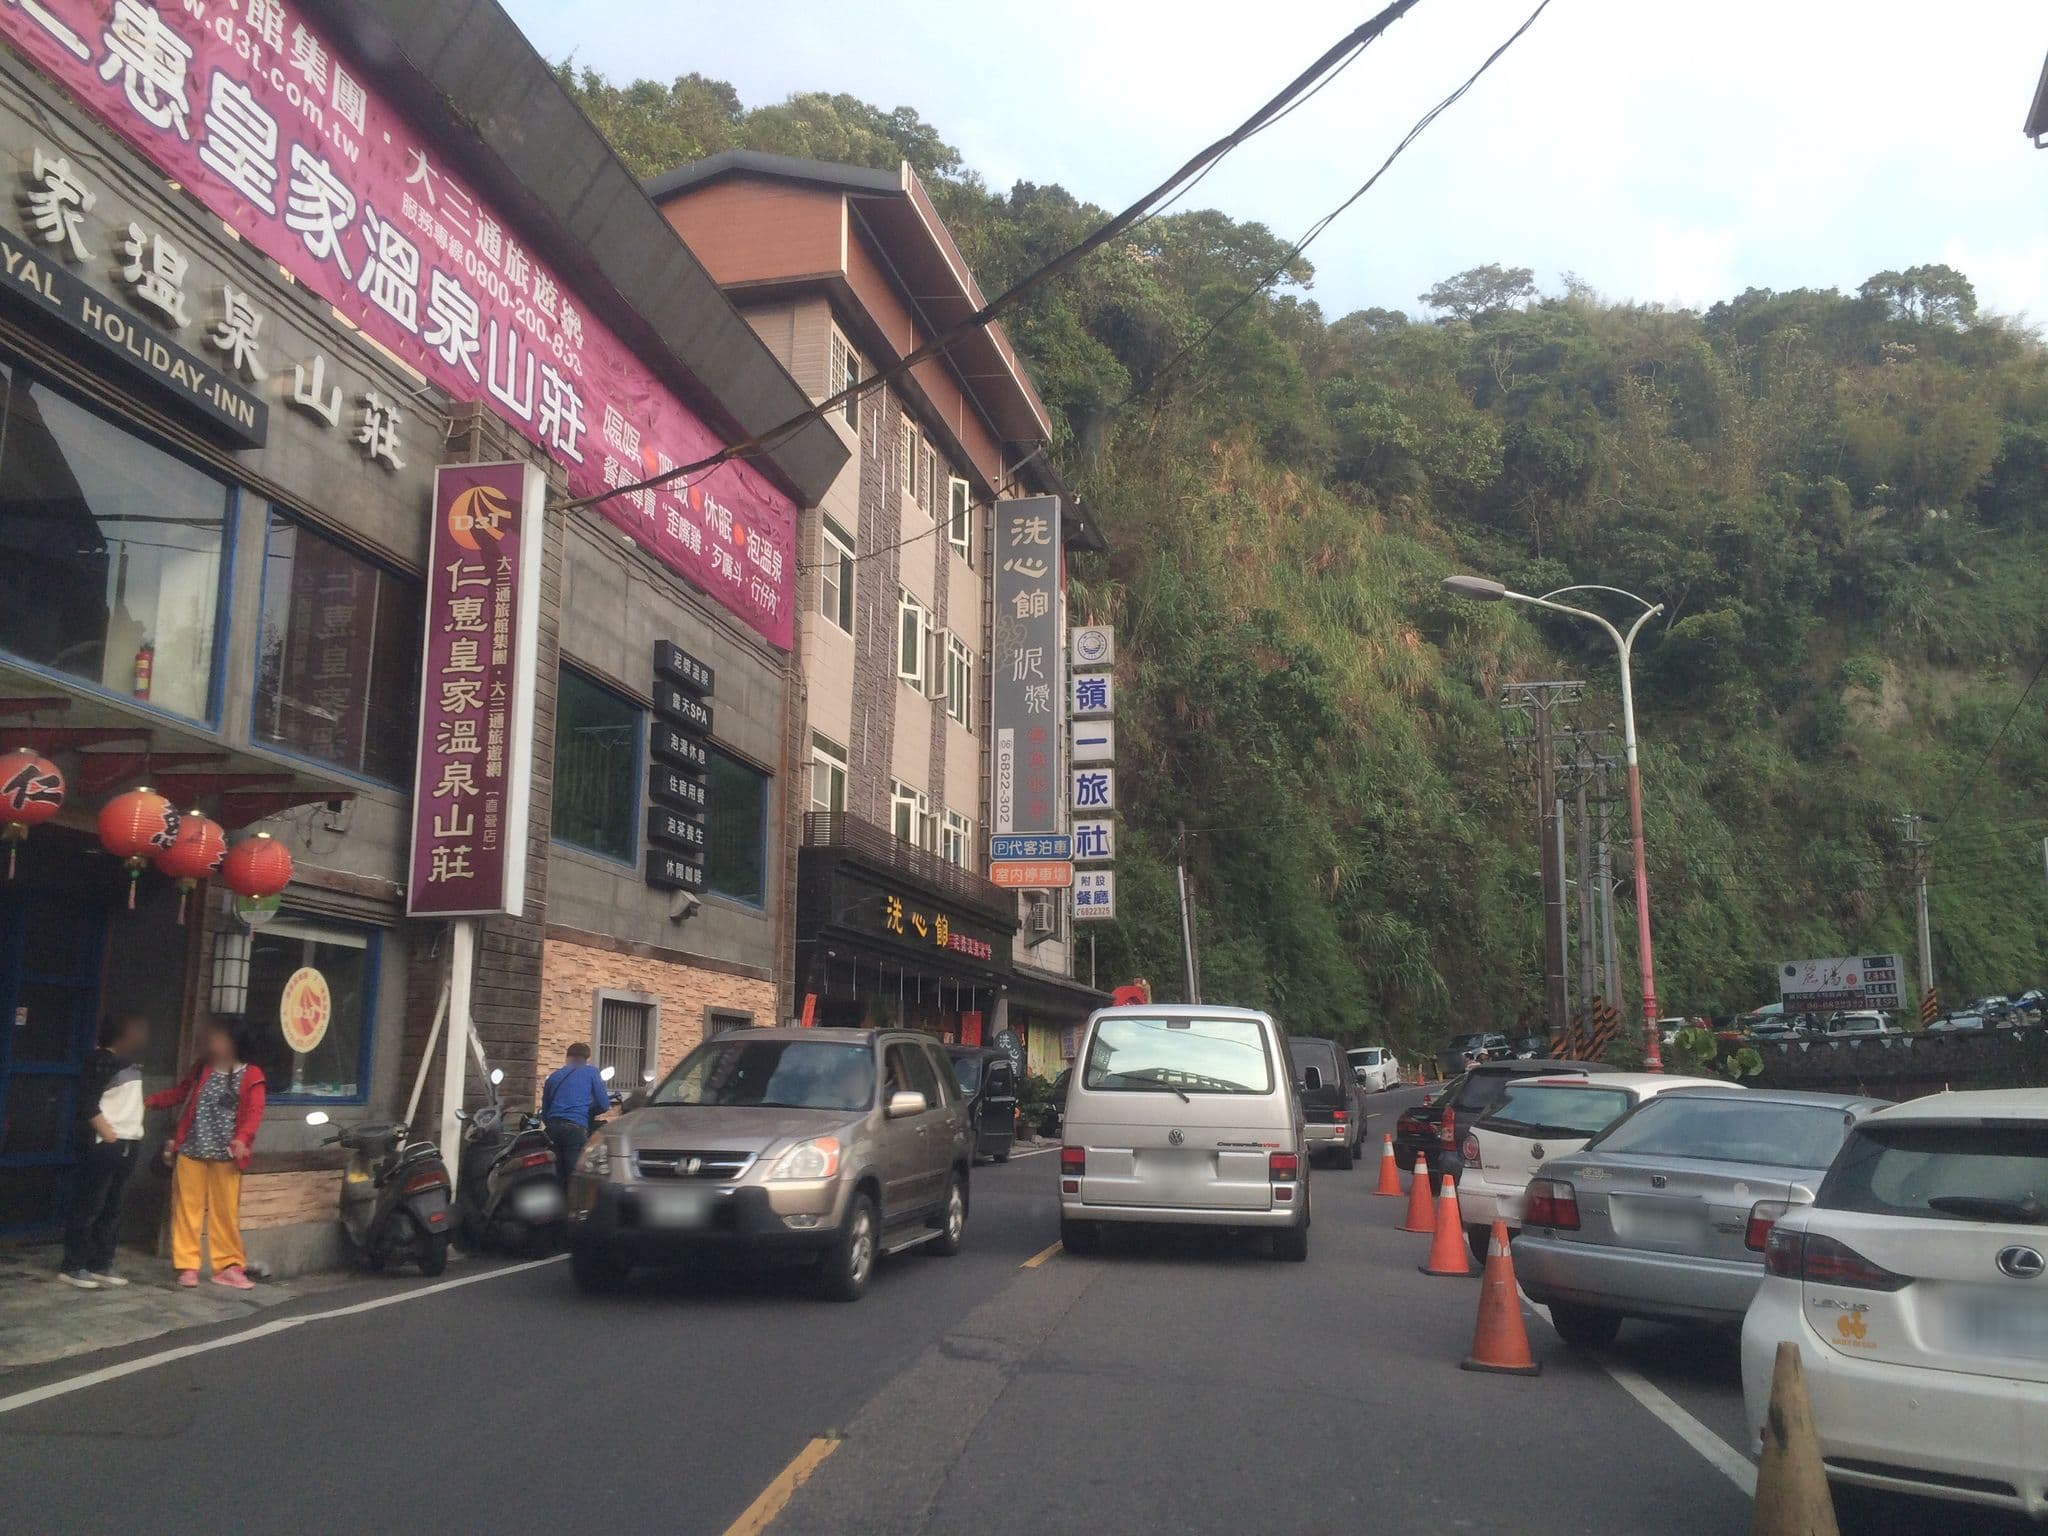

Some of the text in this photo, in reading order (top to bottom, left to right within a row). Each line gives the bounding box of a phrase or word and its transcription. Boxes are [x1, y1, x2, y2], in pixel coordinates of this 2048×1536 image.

[1, 241, 255, 429] YAL HOLIDAY-INN
[1003, 517, 1051, 620] 洗心館
[1000, 753, 1011, 824] 6822-302
[1009, 840, 1068, 856] 代客泊車
[887, 896, 949, 948] 洗心館
